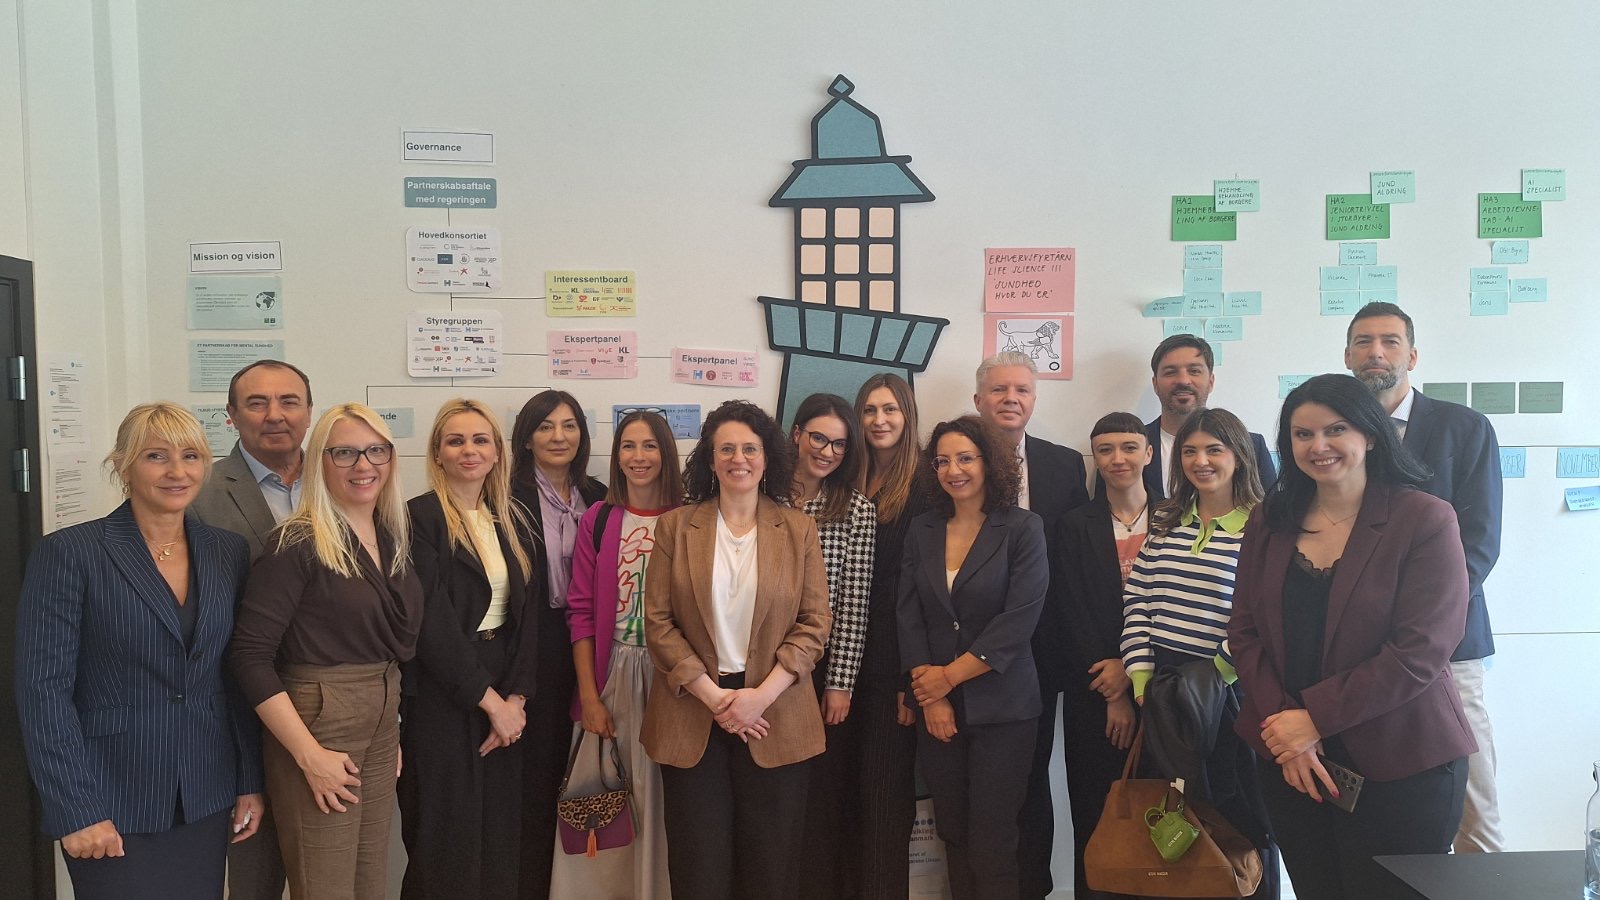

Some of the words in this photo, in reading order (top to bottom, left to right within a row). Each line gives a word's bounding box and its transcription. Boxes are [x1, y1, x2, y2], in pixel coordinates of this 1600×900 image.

[406, 143, 462, 152] Governance
[407, 181, 492, 190] Partnerskabsaftale
[1377, 180, 1396, 188] SUND
[1376, 187, 1407, 196] ALDRING
[1526, 186, 1562, 194] SPECIALIST
[415, 195, 435, 203] med
[437, 196, 486, 206] regeringen
[1330, 197, 1346, 205] HA2
[1483, 195, 1499, 204] HA3
[1330, 206, 1384, 215] SENIORTRIVSEL
[1176, 216, 1195, 225] LING
[1208, 215, 1236, 224] BORGERE
[1330, 225, 1348, 233] SUND
[1350, 223, 1383, 231] ALDRING
[1482, 226, 1525, 234] SPECIALIST
[418, 231, 487, 240] Hovedkonsortiet
[193, 252, 229, 261] Mission
[231, 253, 243, 262] og
[245, 251, 275, 260] vision
[988, 250, 1072, 264] ERHVERVSFYRTÅRN
[987, 266, 1007, 276] LIFE
[1012, 264, 1047, 274] SCIENCE
[553, 275, 628, 284] Interessentboard
[995, 290, 1017, 300] HVOR
[1021, 290, 1032, 299] DU
[426, 317, 483, 326] Styregruppen
[564, 335, 622, 345] Ekspertpanel
[618, 346, 630, 354] KL
[681, 354, 738, 366] Ekspertpanel
